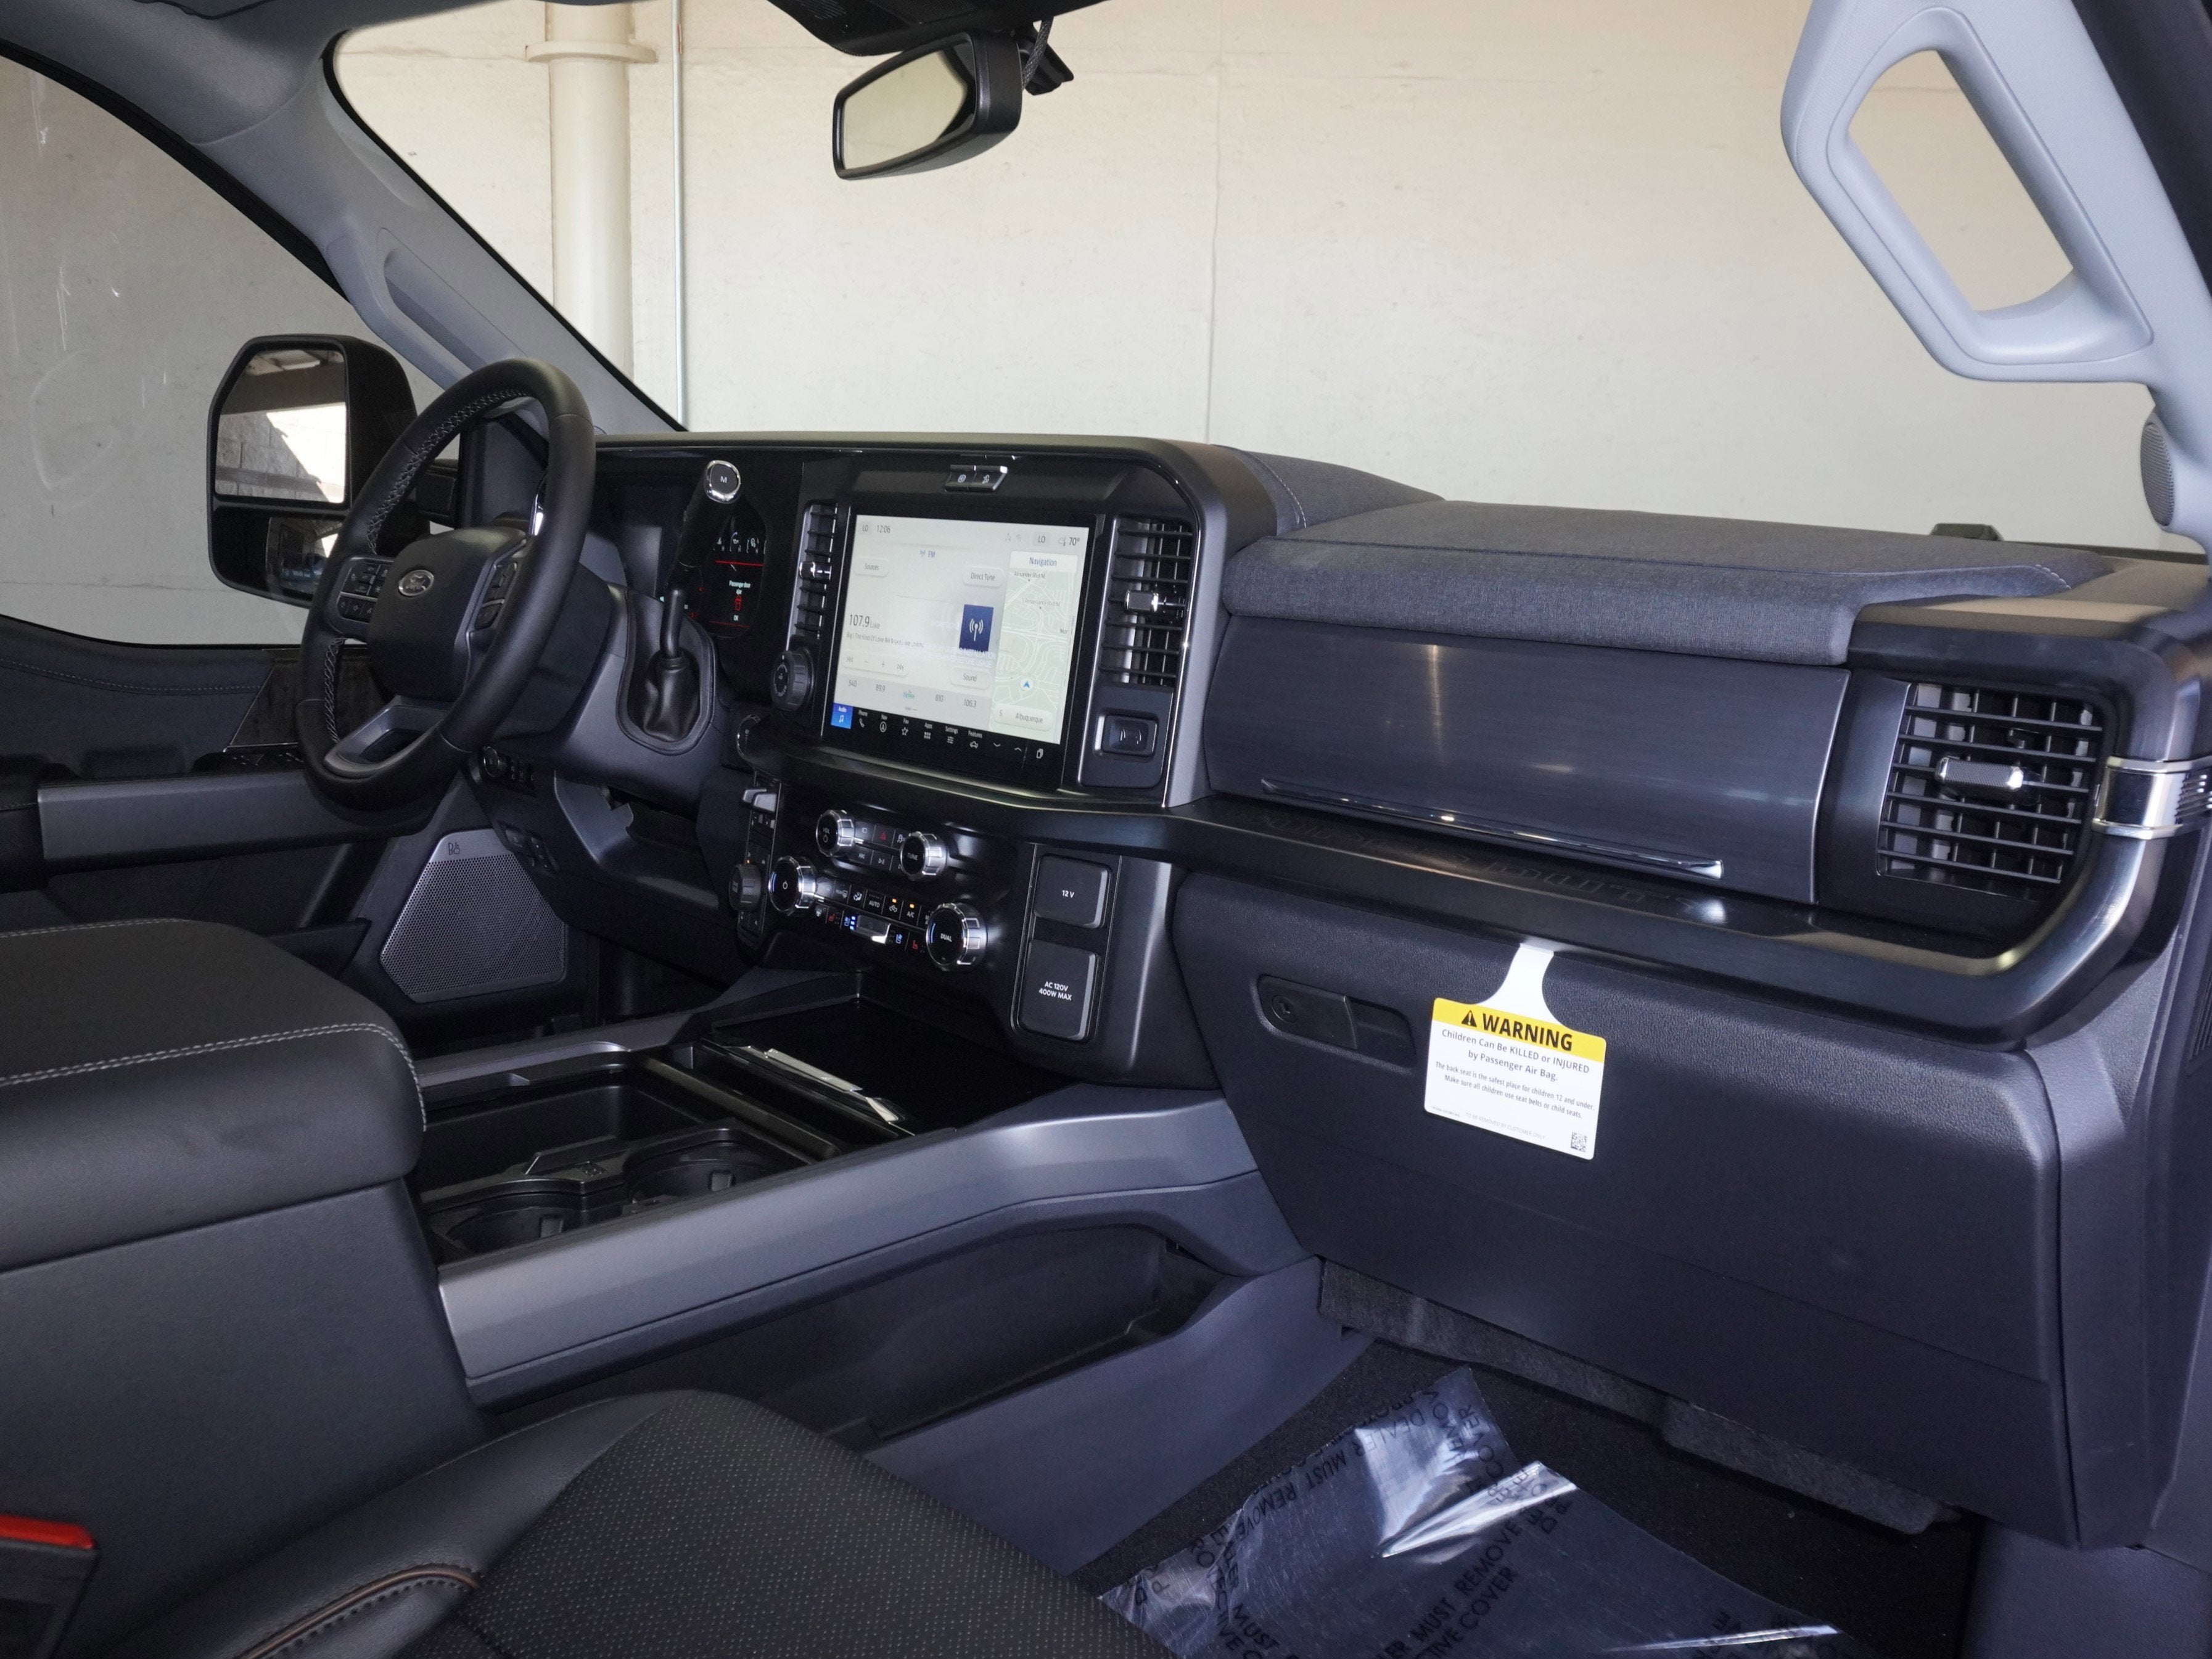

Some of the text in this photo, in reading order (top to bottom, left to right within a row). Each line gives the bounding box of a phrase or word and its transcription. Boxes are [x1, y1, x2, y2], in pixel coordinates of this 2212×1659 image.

[877, 525, 891, 533] 12:06
[1038, 535, 1080, 546] LO 70°
[864, 563, 879, 571] Sources
[1029, 557, 1057, 567] Navigation
[971, 573, 996, 582] Direct Tune
[849, 614, 881, 630] 107.9 Luke
[963, 673, 977, 683] Sound
[848, 680, 858, 688] 540
[876, 683, 886, 693] 89.9
[935, 694, 944, 703] 810
[964, 699, 977, 708] 106.3
[1015, 712, 1043, 723] Albuquerque
[945, 726, 959, 735] Settings
[968, 730, 983, 739] Features
[907, 852, 919, 860] TUNE
[1061, 889, 1075, 899] 12 V
[869, 900, 880, 908] AUTO
[907, 910, 915, 918] A/C
[940, 933, 953, 942] DUAL
[1044, 981, 1069, 993] AC 120V
[1038, 987, 1072, 1002] 400W MAX
[1482, 1013, 1573, 1052] WARNING
[1442, 1029, 1590, 1074] Children Can Be KILLED or INJURED
[1468, 1050, 1558, 1082] by Passenger Air Bag.
[1436, 1061, 1445, 1070] The
[1447, 1064, 1459, 1074] back
[1460, 1069, 1472, 1077] seat
[1478, 1073, 1488, 1081] the
[1489, 1076, 1505, 1086] safest
[1506, 1078, 1521, 1092] place
[1522, 1084, 1531, 1093] for
[1532, 1088, 1555, 1099] children
[1556, 1093, 1563, 1102] 12
[1564, 1095, 1576, 1106] and
[1576, 1098, 1595, 1111] under.
[1444, 1075, 1583, 1119] Make sure all children use seat belts or child seats.
[1479, 1116, 1500, 1127] REMOVED
[1507, 1125, 1532, 1136] CUSTOMER
[1533, 1132, 1546, 1140] ONLY
[1354, 1407, 1425, 1457] DEALER
[1305, 1451, 1348, 1491] MUST
[1409, 1597, 1457, 1642] MUST
[1454, 1520, 1523, 1596] REMOVE
[1459, 1566, 1518, 1630] COVER
